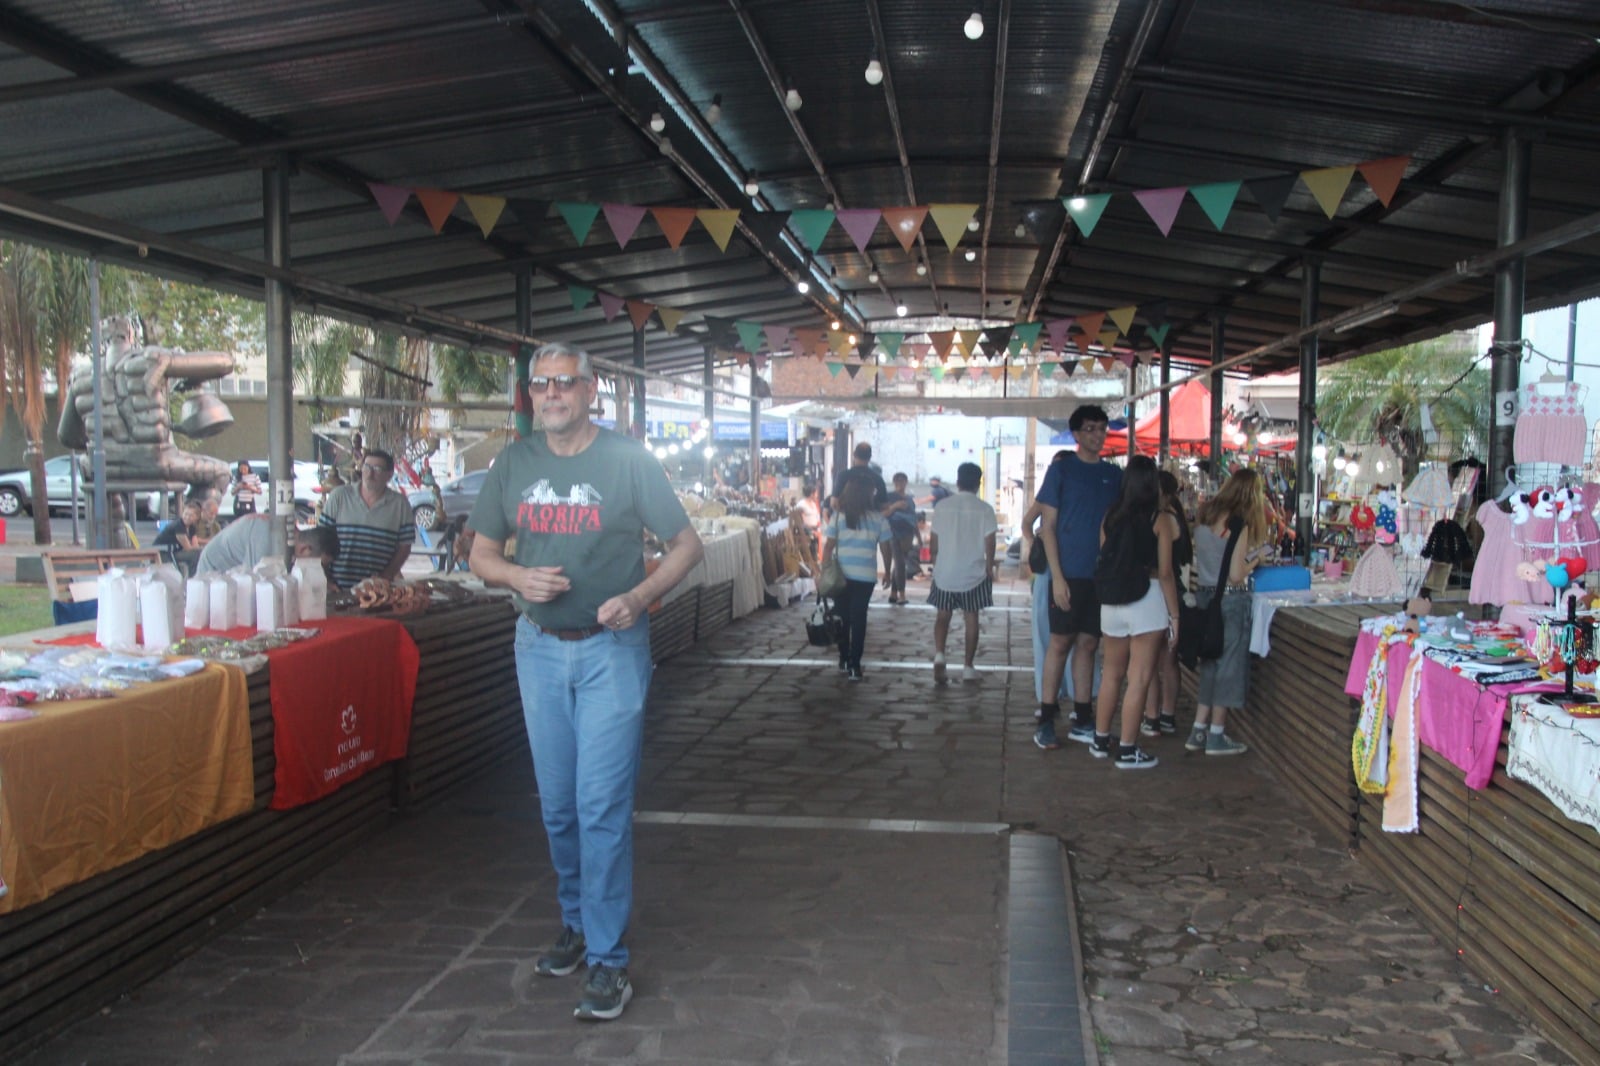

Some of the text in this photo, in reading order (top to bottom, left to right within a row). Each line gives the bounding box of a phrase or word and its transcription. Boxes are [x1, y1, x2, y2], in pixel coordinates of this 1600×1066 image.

[1503, 400, 1514, 416] 9
[1304, 499, 1311, 510] 7
[516, 503, 604, 531] FLORIPA
[530, 518, 582, 534] BRASIL
